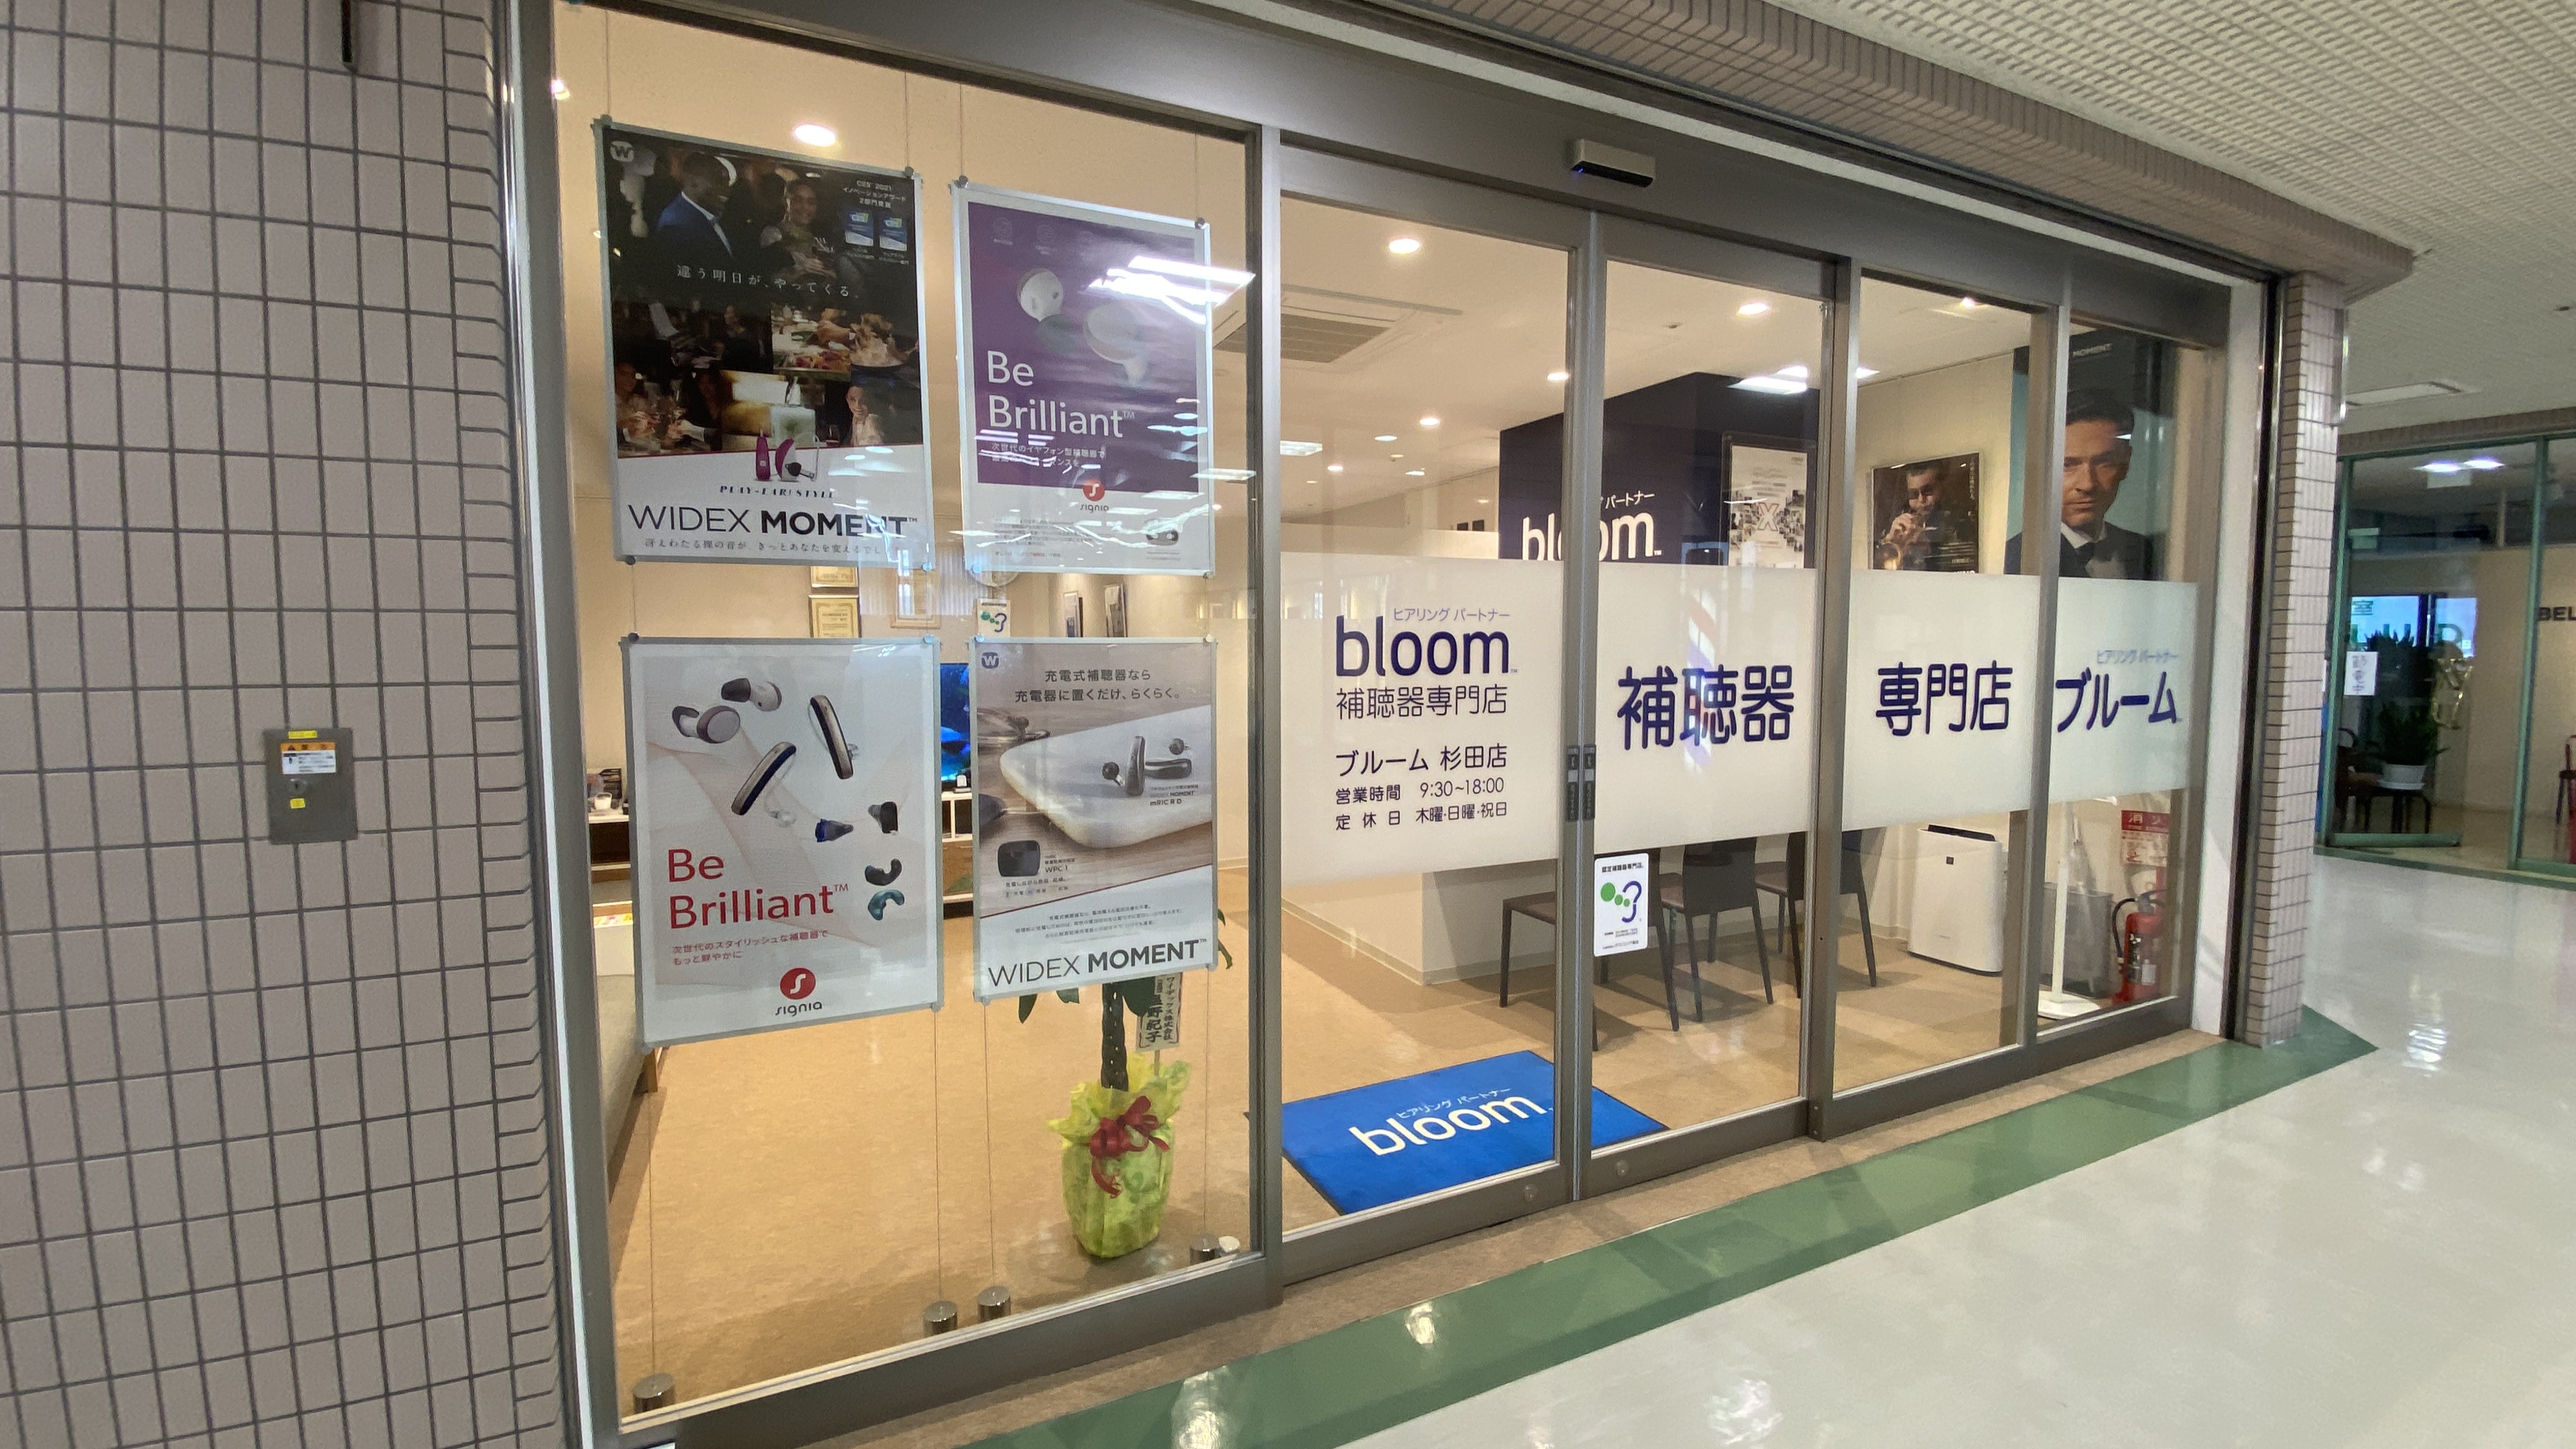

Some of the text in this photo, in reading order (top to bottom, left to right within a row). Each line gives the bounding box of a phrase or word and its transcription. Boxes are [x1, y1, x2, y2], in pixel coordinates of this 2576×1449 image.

[987, 350, 1034, 387] Be
[1080, 504, 1109, 513] signia
[1606, 491, 1655, 509] パートナー
[628, 503, 751, 533] WIDEX
[1522, 513, 1653, 561] blm
[1393, 608, 1510, 622] ヒアリング パートナー
[1336, 615, 1509, 677] bloom
[1045, 668, 1151, 683] 充電式補聴器なら
[1015, 686, 1179, 703] 充電器に置くだけ、らくらく。
[1336, 684, 1508, 720] 補聴器専門店
[1617, 660, 2177, 750] 補聴器 専門店 ブルーム
[1336, 743, 1508, 777] ブルーム 杉田店
[1336, 785, 1400, 805] 営業時間
[668, 848, 724, 882] Be
[672, 930, 829, 954] 次世代のスタイリッシュな補聴器で
[988, 955, 1080, 987] WIDEX
[775, 1002, 823, 1017] signia
[1397, 1100, 1452, 1119] ヒアリング
[1348, 1095, 1548, 1156] bloom
